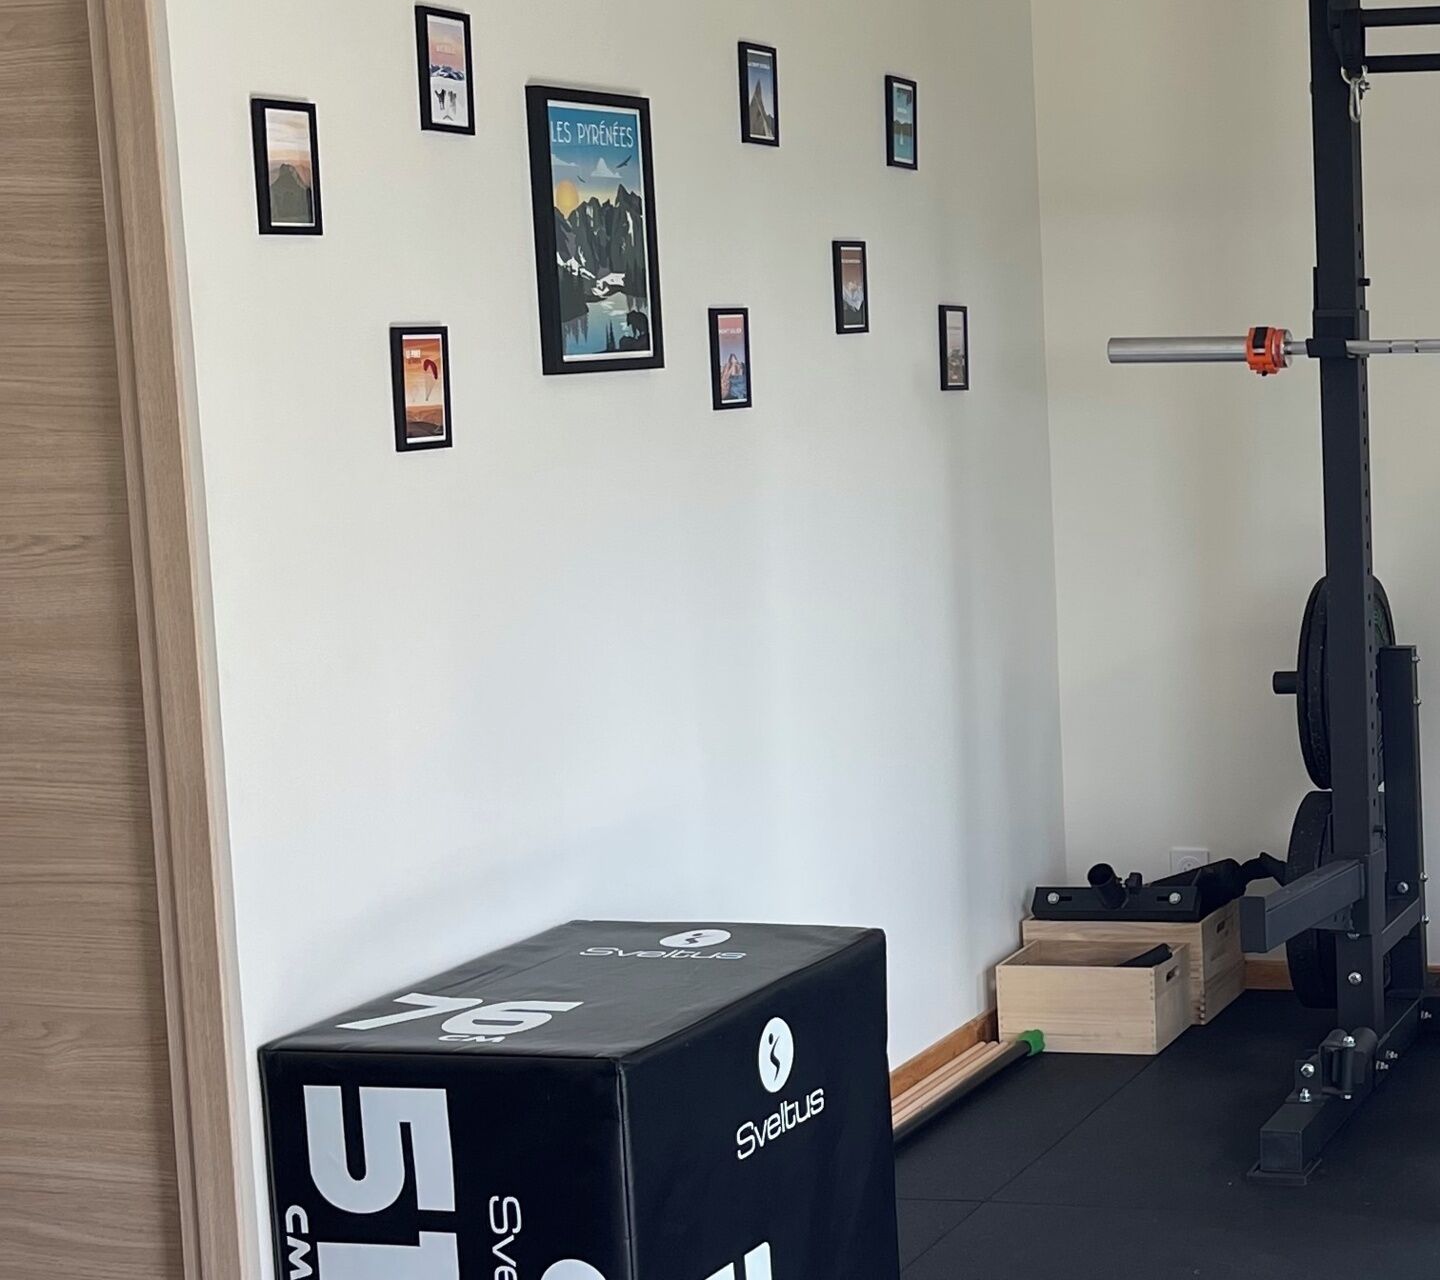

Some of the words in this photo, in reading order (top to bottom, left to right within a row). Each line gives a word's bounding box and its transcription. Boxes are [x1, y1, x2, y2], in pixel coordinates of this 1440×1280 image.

[550, 120, 572, 143] LES
[577, 120, 634, 148] PYRÉNÉES
[579, 946, 747, 961] Sveltus
[335, 992, 584, 1035] 76
[438, 1033, 505, 1043] CM
[736, 1086, 825, 1160] Sveltus
[285, 1204, 313, 1280] CM
